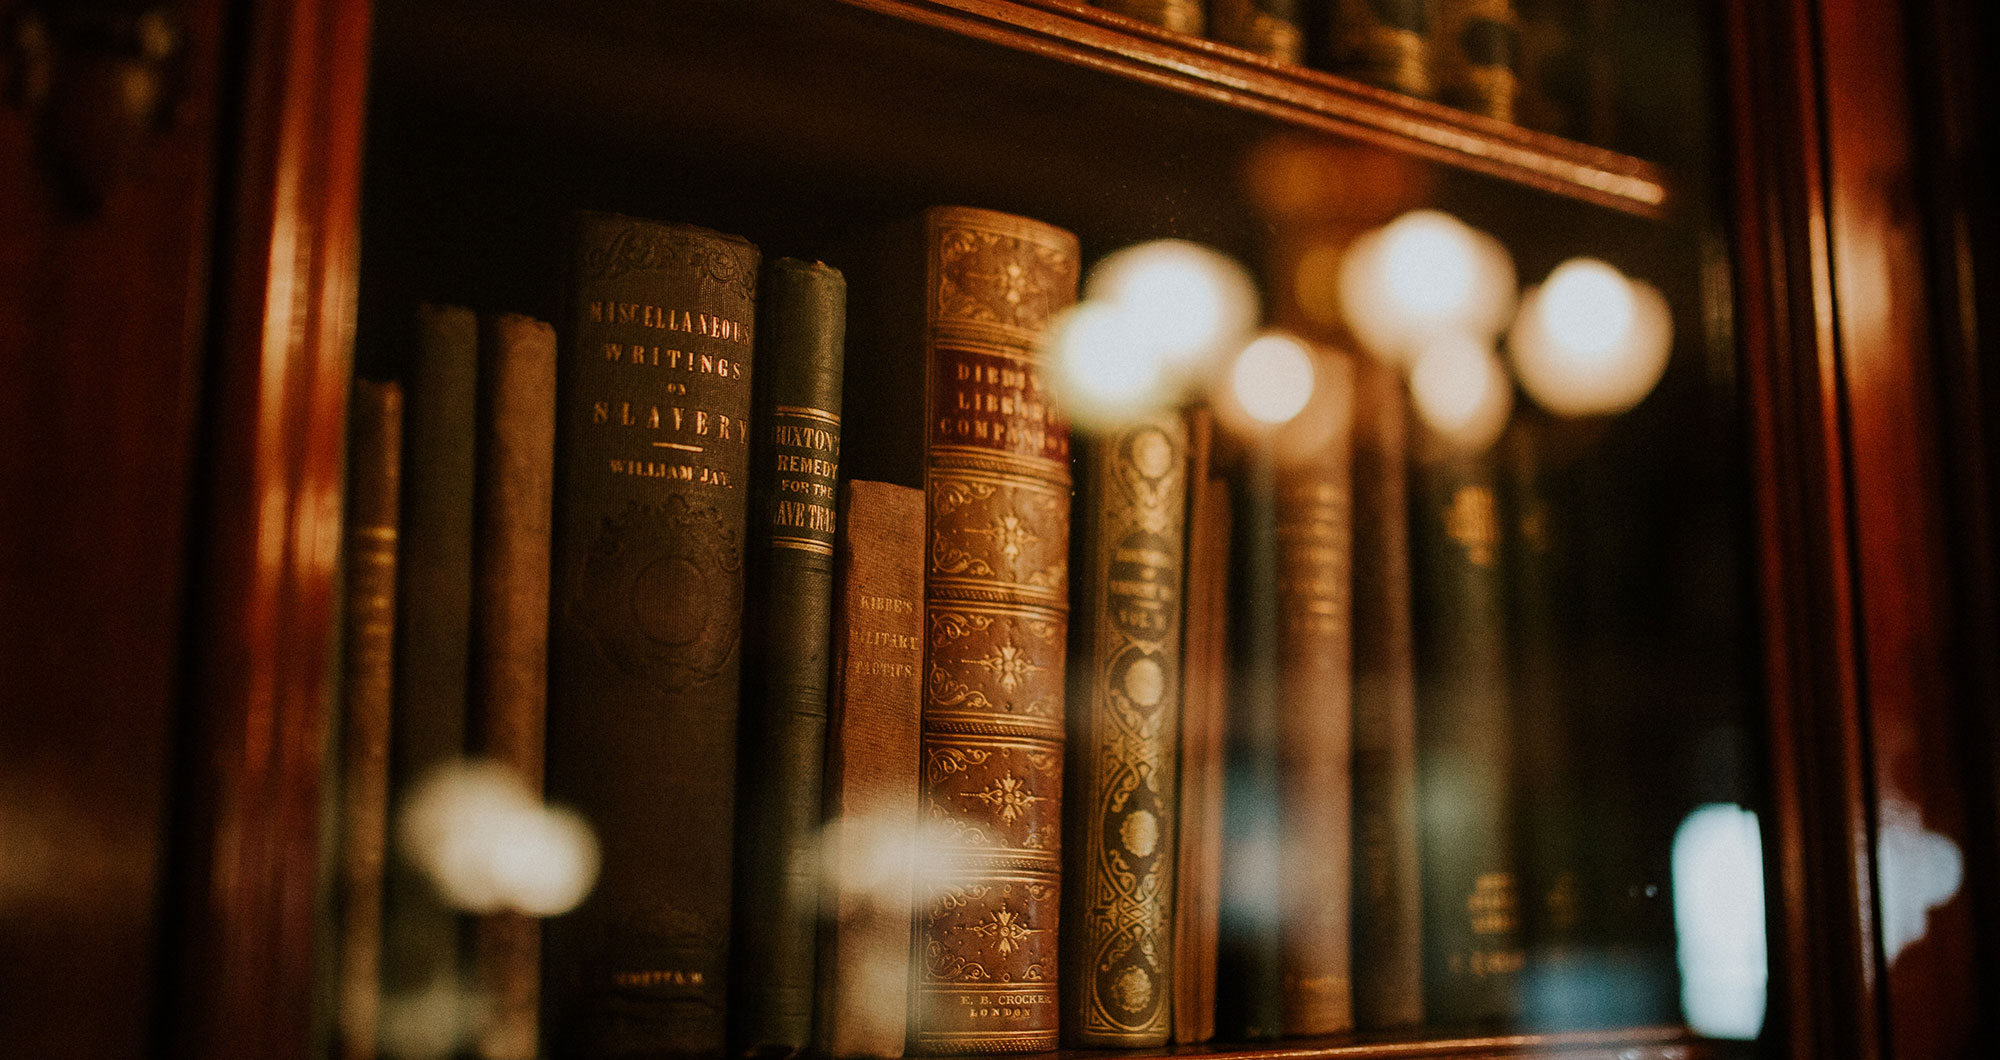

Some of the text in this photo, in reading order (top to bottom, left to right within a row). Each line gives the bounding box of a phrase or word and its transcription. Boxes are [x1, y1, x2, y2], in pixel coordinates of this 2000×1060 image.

[590, 301, 750, 345] MISCELLANEOUS
[605, 343, 742, 381] WRITINGS
[594, 401, 747, 444] SLAVERY
[610, 459, 733, 489] WILLIAM JAY.
[777, 454, 838, 480] REMEDY
[782, 479, 833, 499] FOR THE
[970, 1007, 1032, 1018] LONDON
